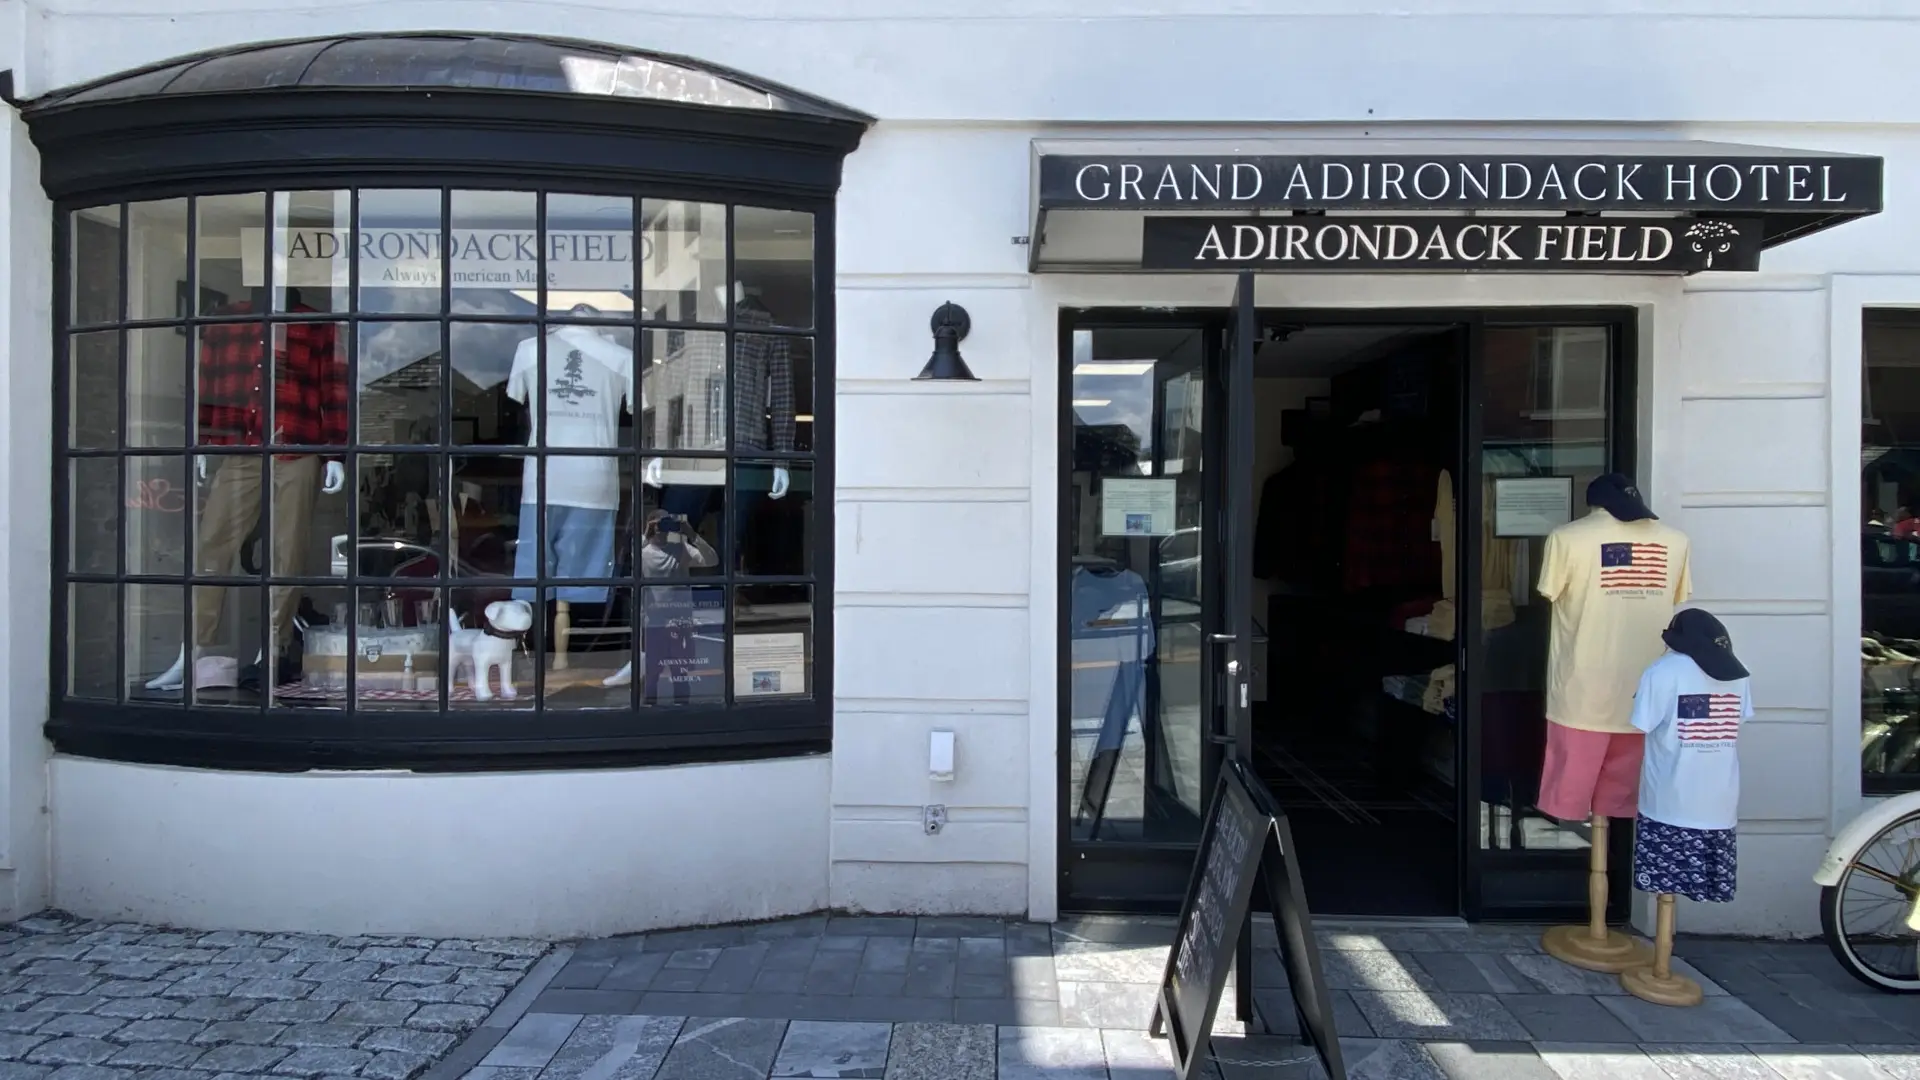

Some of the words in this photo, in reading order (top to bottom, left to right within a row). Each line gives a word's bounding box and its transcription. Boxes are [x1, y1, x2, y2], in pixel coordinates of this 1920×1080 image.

[1075, 163, 1263, 200] GRAND
[1283, 162, 1644, 201] ADIRONDACK
[1665, 164, 1848, 202] HOTEL
[1195, 224, 1523, 261] ADIRONDACK
[1534, 225, 1674, 262] FIELD
[382, 267, 437, 285] Always
[453, 269, 511, 283] merican
[516, 268, 556, 283] Mae
